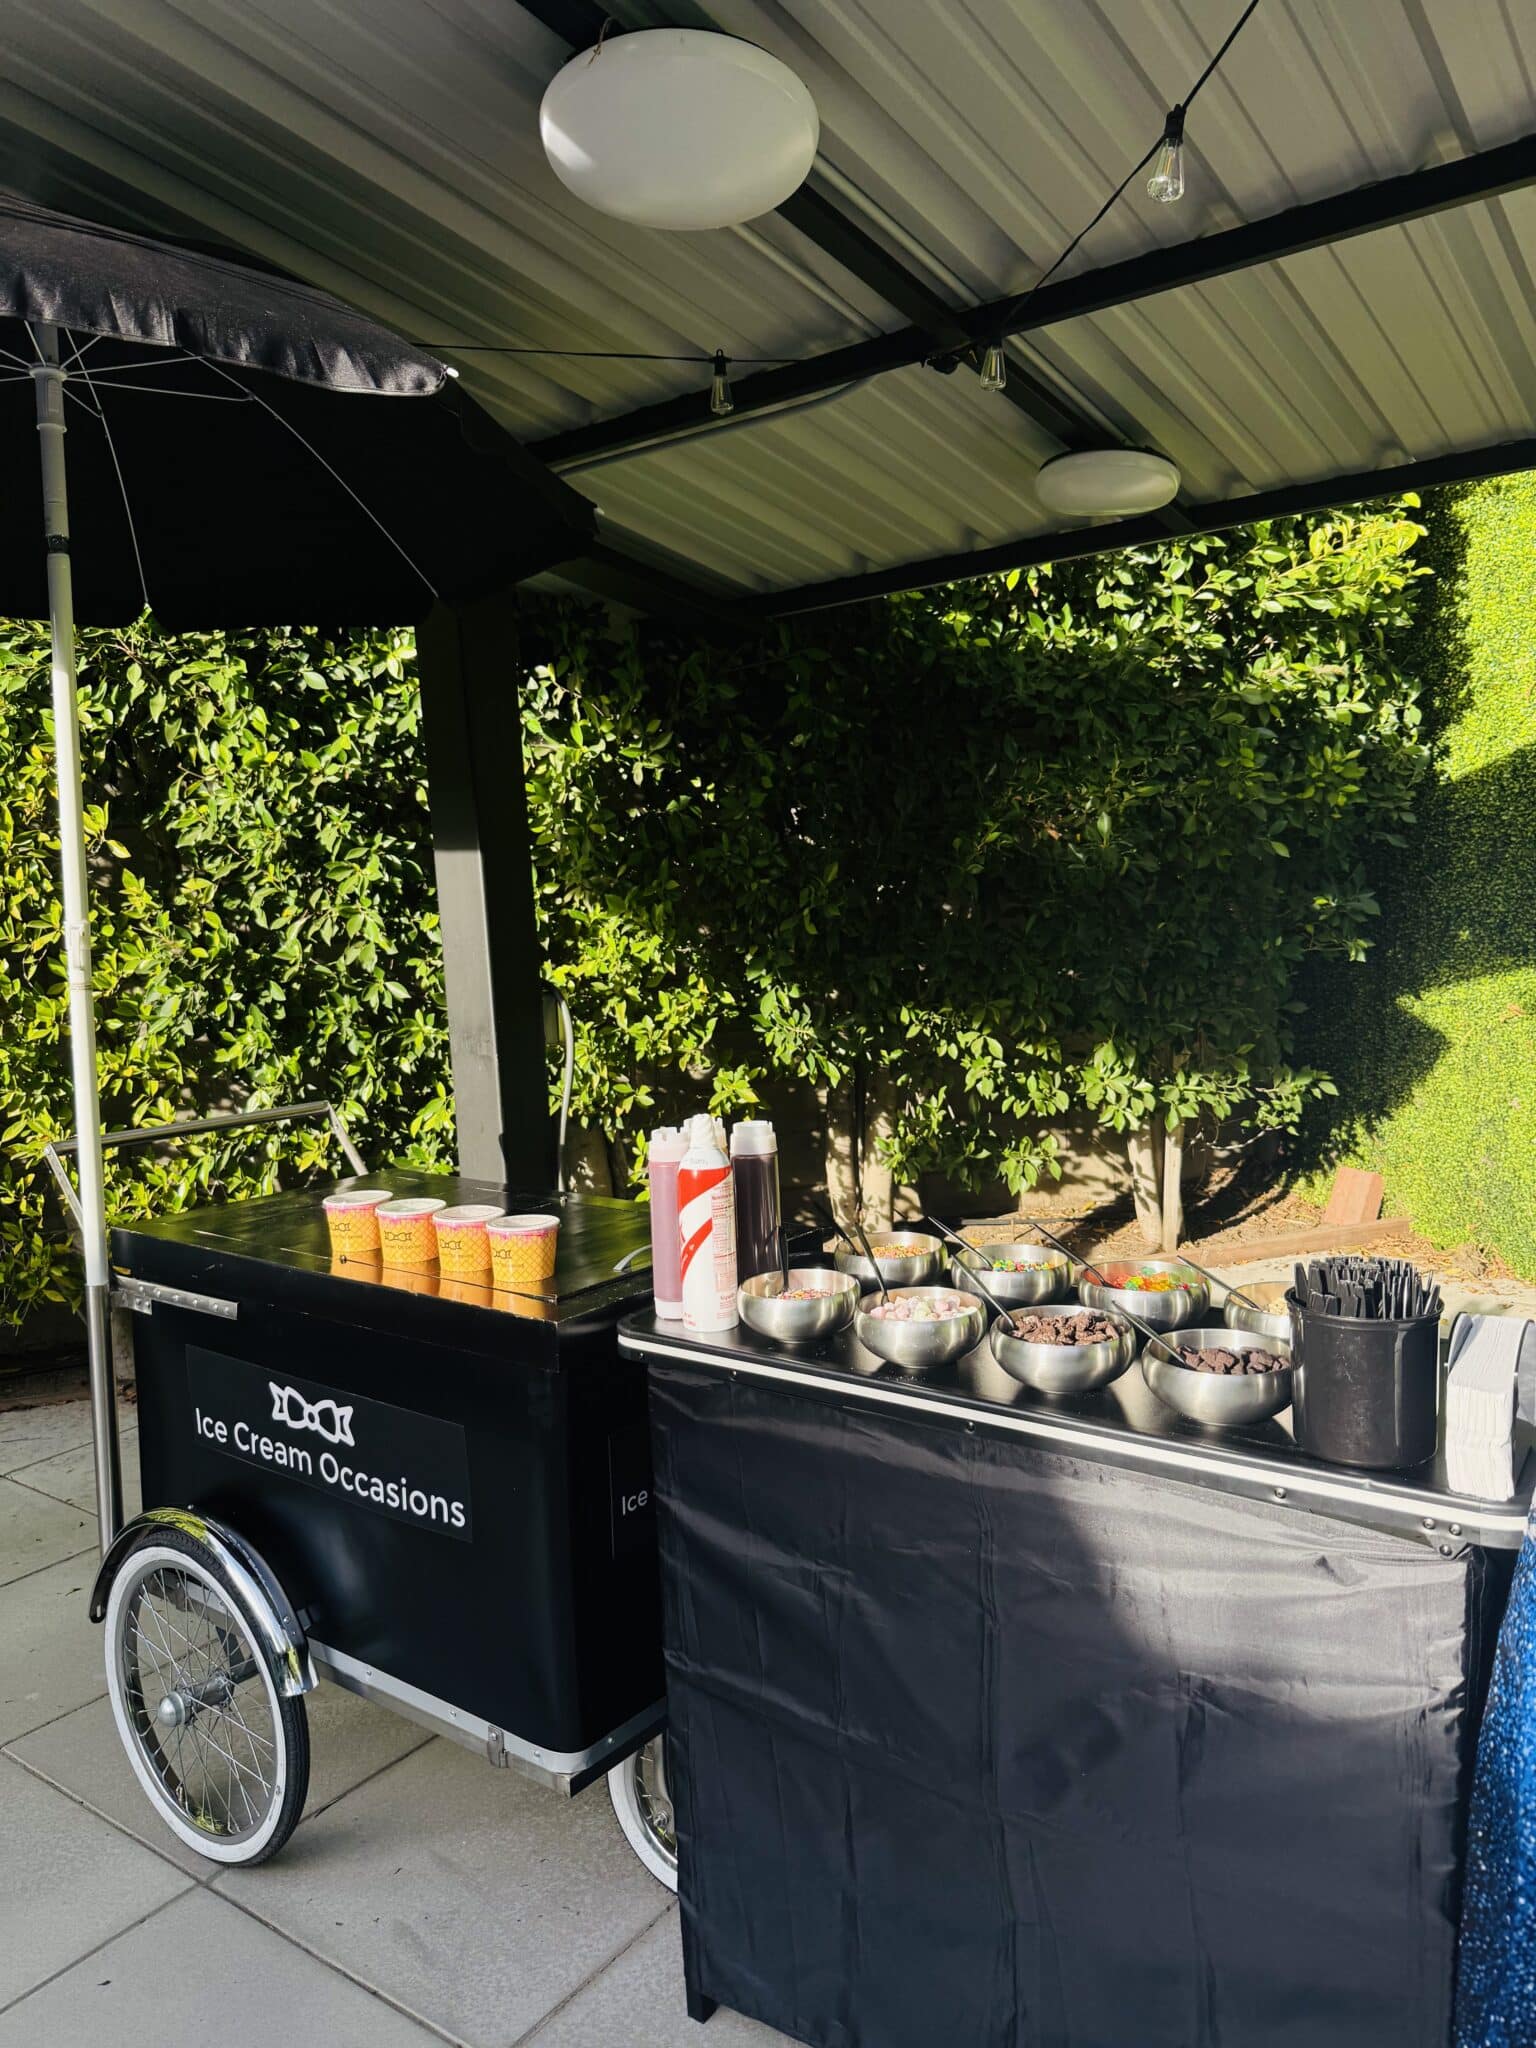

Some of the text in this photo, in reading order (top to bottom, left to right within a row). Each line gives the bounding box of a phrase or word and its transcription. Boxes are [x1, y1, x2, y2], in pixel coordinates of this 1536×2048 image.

[195, 1407, 466, 1528] Ice Cream Occasions
[621, 1489, 649, 1517] Ice
